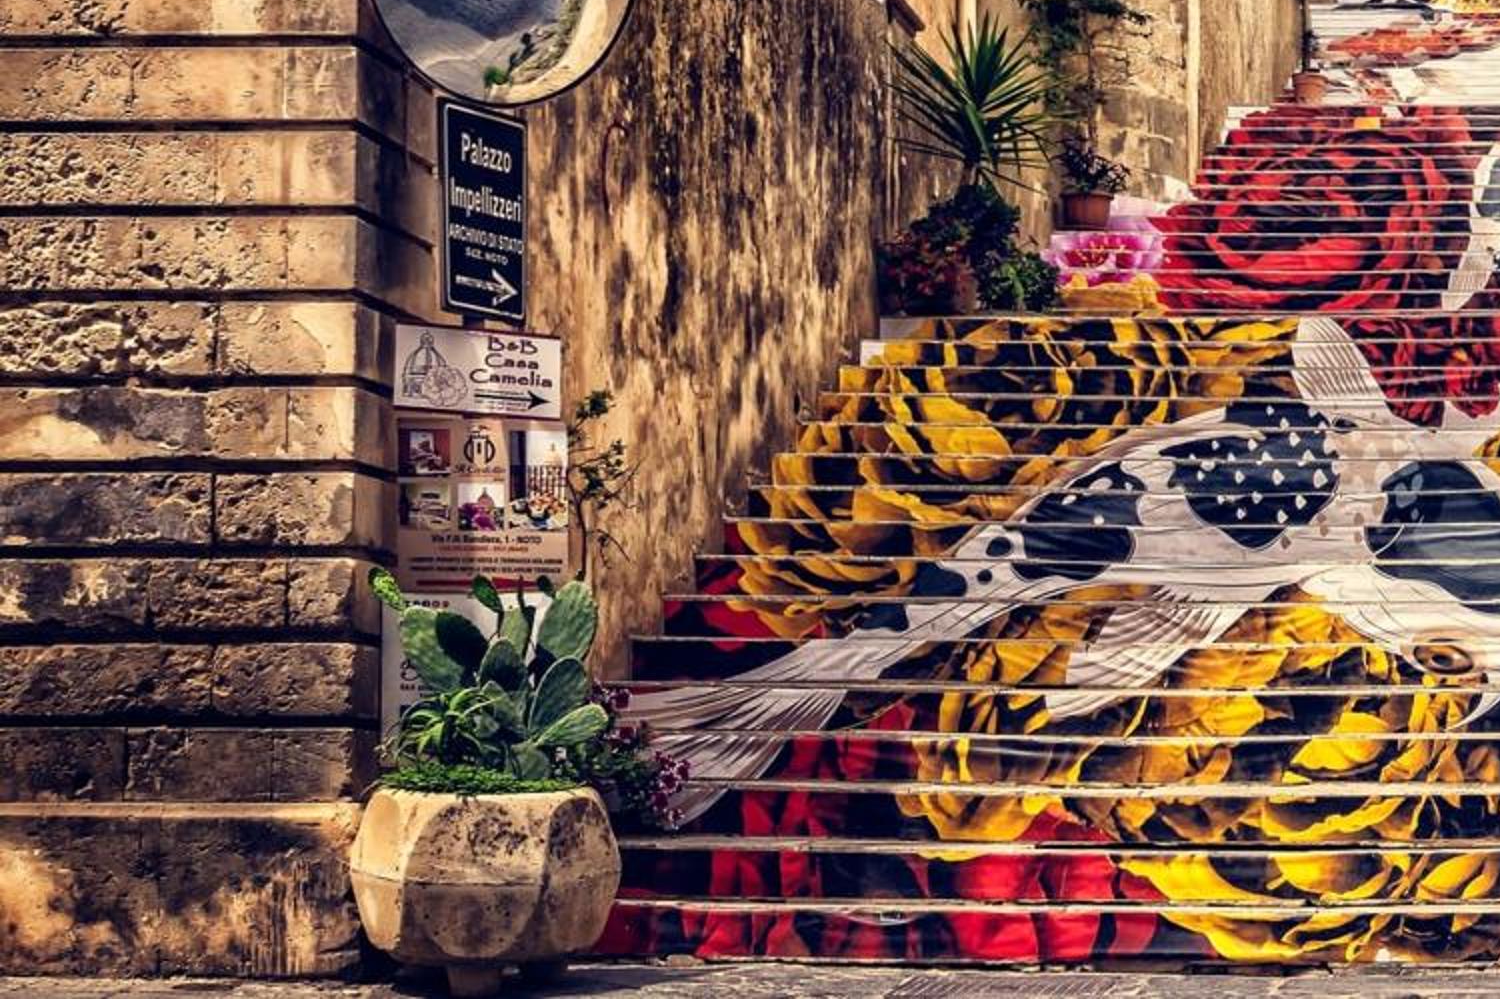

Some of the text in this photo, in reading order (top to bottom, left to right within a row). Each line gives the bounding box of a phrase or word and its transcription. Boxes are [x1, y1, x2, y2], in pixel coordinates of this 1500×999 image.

[461, 132, 512, 173] Palazzo
[450, 176, 522, 223] Impellizzeri
[449, 223, 487, 246] ARCHIVIO
[499, 234, 524, 255] STATO
[488, 335, 538, 354] B&B
[485, 353, 539, 369] Casa
[470, 368, 552, 387] Camelia
